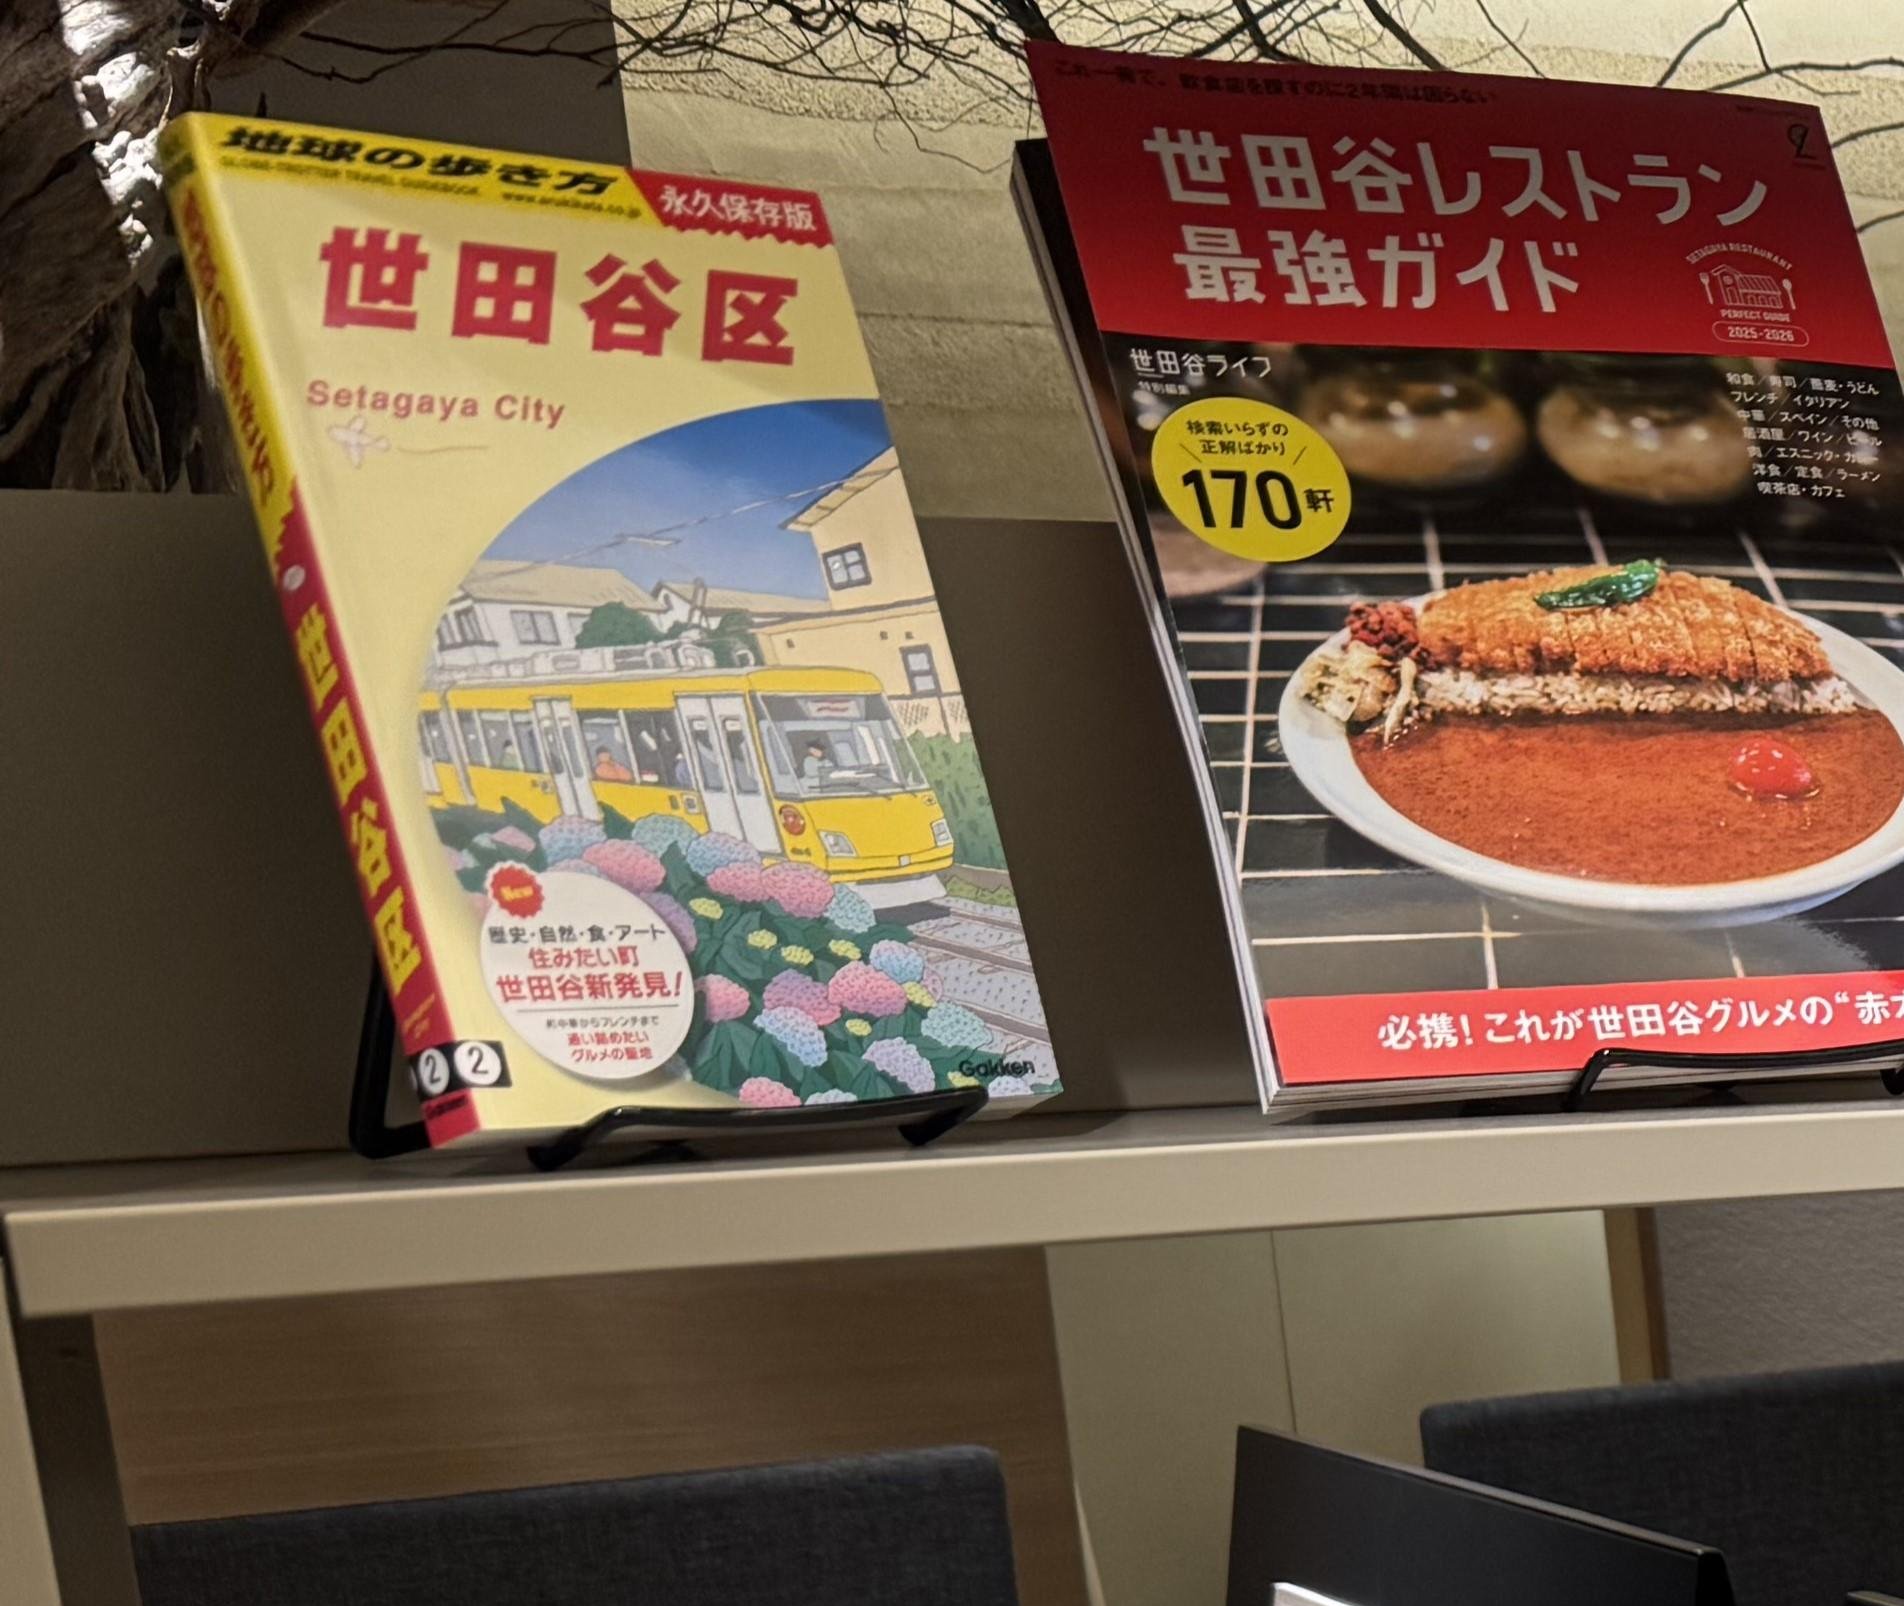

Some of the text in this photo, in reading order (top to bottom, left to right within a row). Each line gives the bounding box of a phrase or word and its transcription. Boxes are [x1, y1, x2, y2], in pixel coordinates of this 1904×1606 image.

[219, 124, 618, 197] 地球の歩き方
[1143, 126, 1768, 229] 世田谷レストラン
[660, 184, 816, 231] 永久保存版
[1173, 224, 1580, 312] 最強ガイド
[320, 226, 798, 366] 世田谷区
[1129, 348, 1272, 379] 世田谷ライフ
[305, 379, 565, 431] Setagaya City
[1186, 419, 1289, 438] 検索いらずの
[1200, 439, 1286, 456] 正解ばかり
[296, 602, 423, 996] 世田谷区
[528, 945, 639, 969] 住みたい町
[496, 970, 682, 1003] 世田谷新発見!
[957, 1057, 1036, 1080] Gakken
